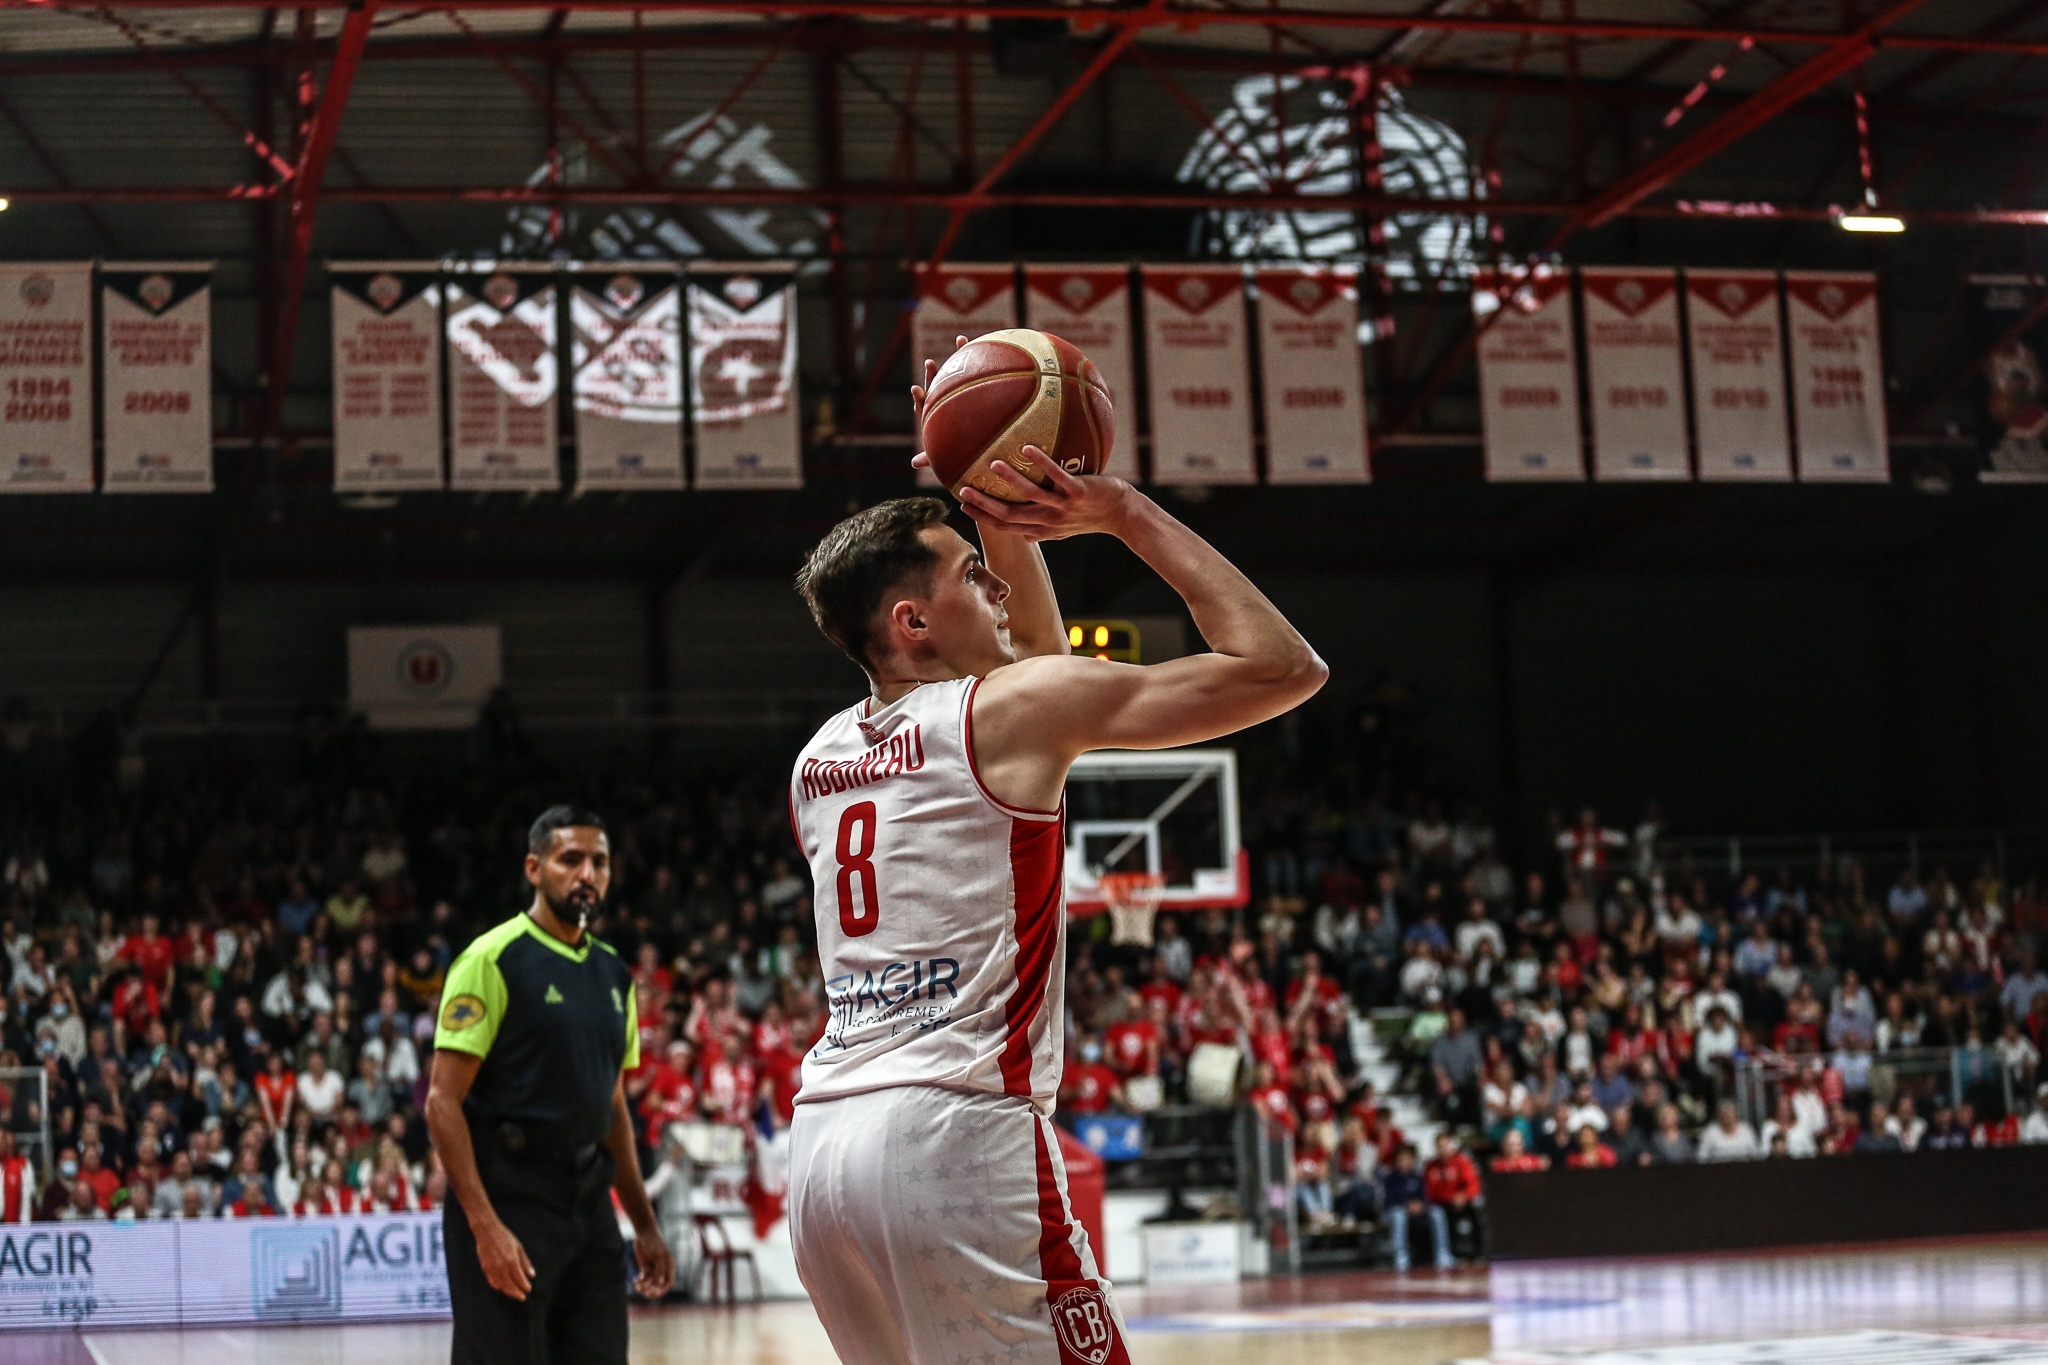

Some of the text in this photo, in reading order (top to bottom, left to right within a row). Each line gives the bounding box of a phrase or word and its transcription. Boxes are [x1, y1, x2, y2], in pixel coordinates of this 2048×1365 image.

[801, 724, 925, 802] ROBINEAU
[835, 800, 879, 938] 8
[856, 957, 960, 1013] AGIR
[0, 1232, 93, 1276] AGIR
[1065, 1301, 1107, 1349] CB
